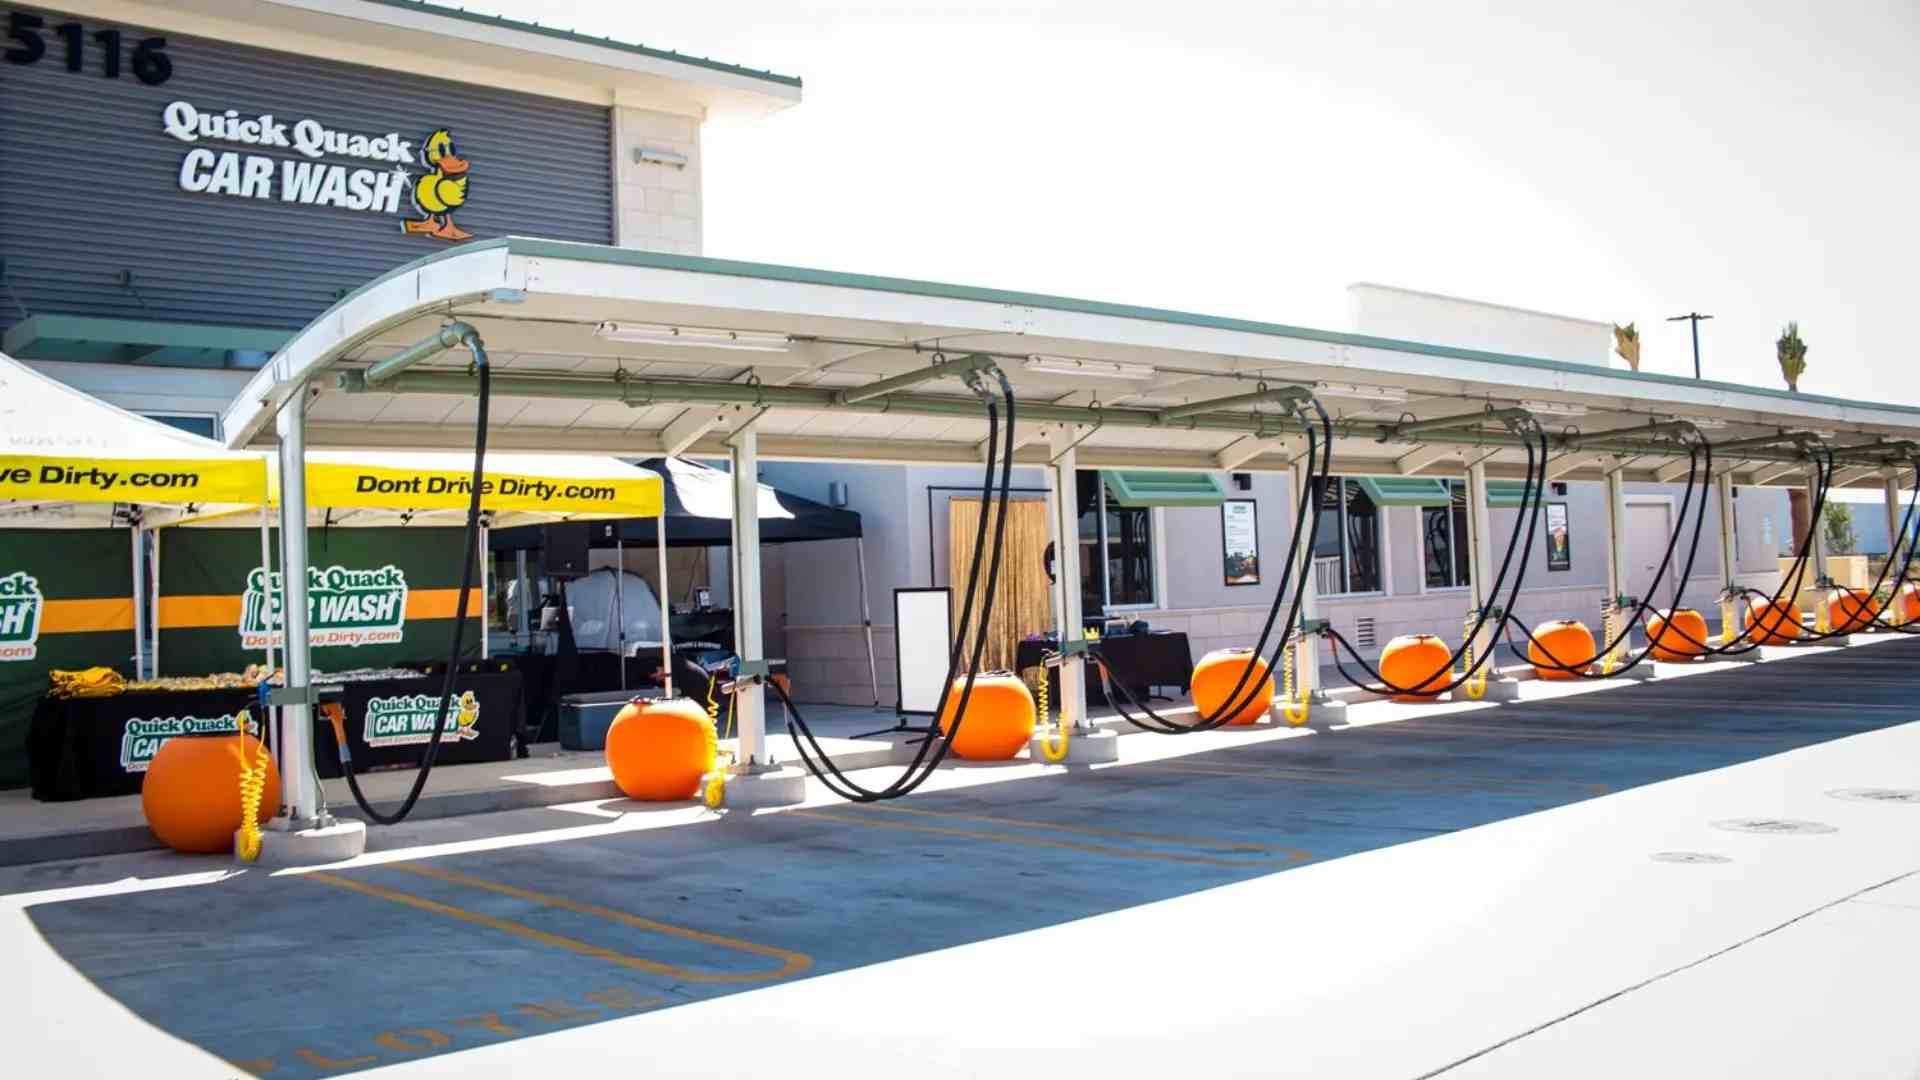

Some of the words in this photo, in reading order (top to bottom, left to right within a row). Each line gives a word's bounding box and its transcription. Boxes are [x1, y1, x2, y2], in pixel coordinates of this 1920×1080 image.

[3, 12, 173, 86] 5116
[163, 101, 291, 147] Quick
[294, 119, 414, 163] Quack
[179, 149, 274, 198] CAR
[281, 161, 406, 213] WASH
[40, 465, 199, 490] Dirty.com
[356, 475, 422, 494] Dont
[499, 478, 616, 501] Dirty.com
[250, 571, 325, 592] Quk
[326, 570, 401, 592] Quack
[319, 593, 397, 623] WASH
[370, 698, 413, 713] Quick
[415, 696, 460, 711] Quk
[128, 719, 179, 735] Quick
[182, 717, 235, 733] Quack
[375, 713, 408, 733] CAR
[411, 711, 459, 731] WAH
